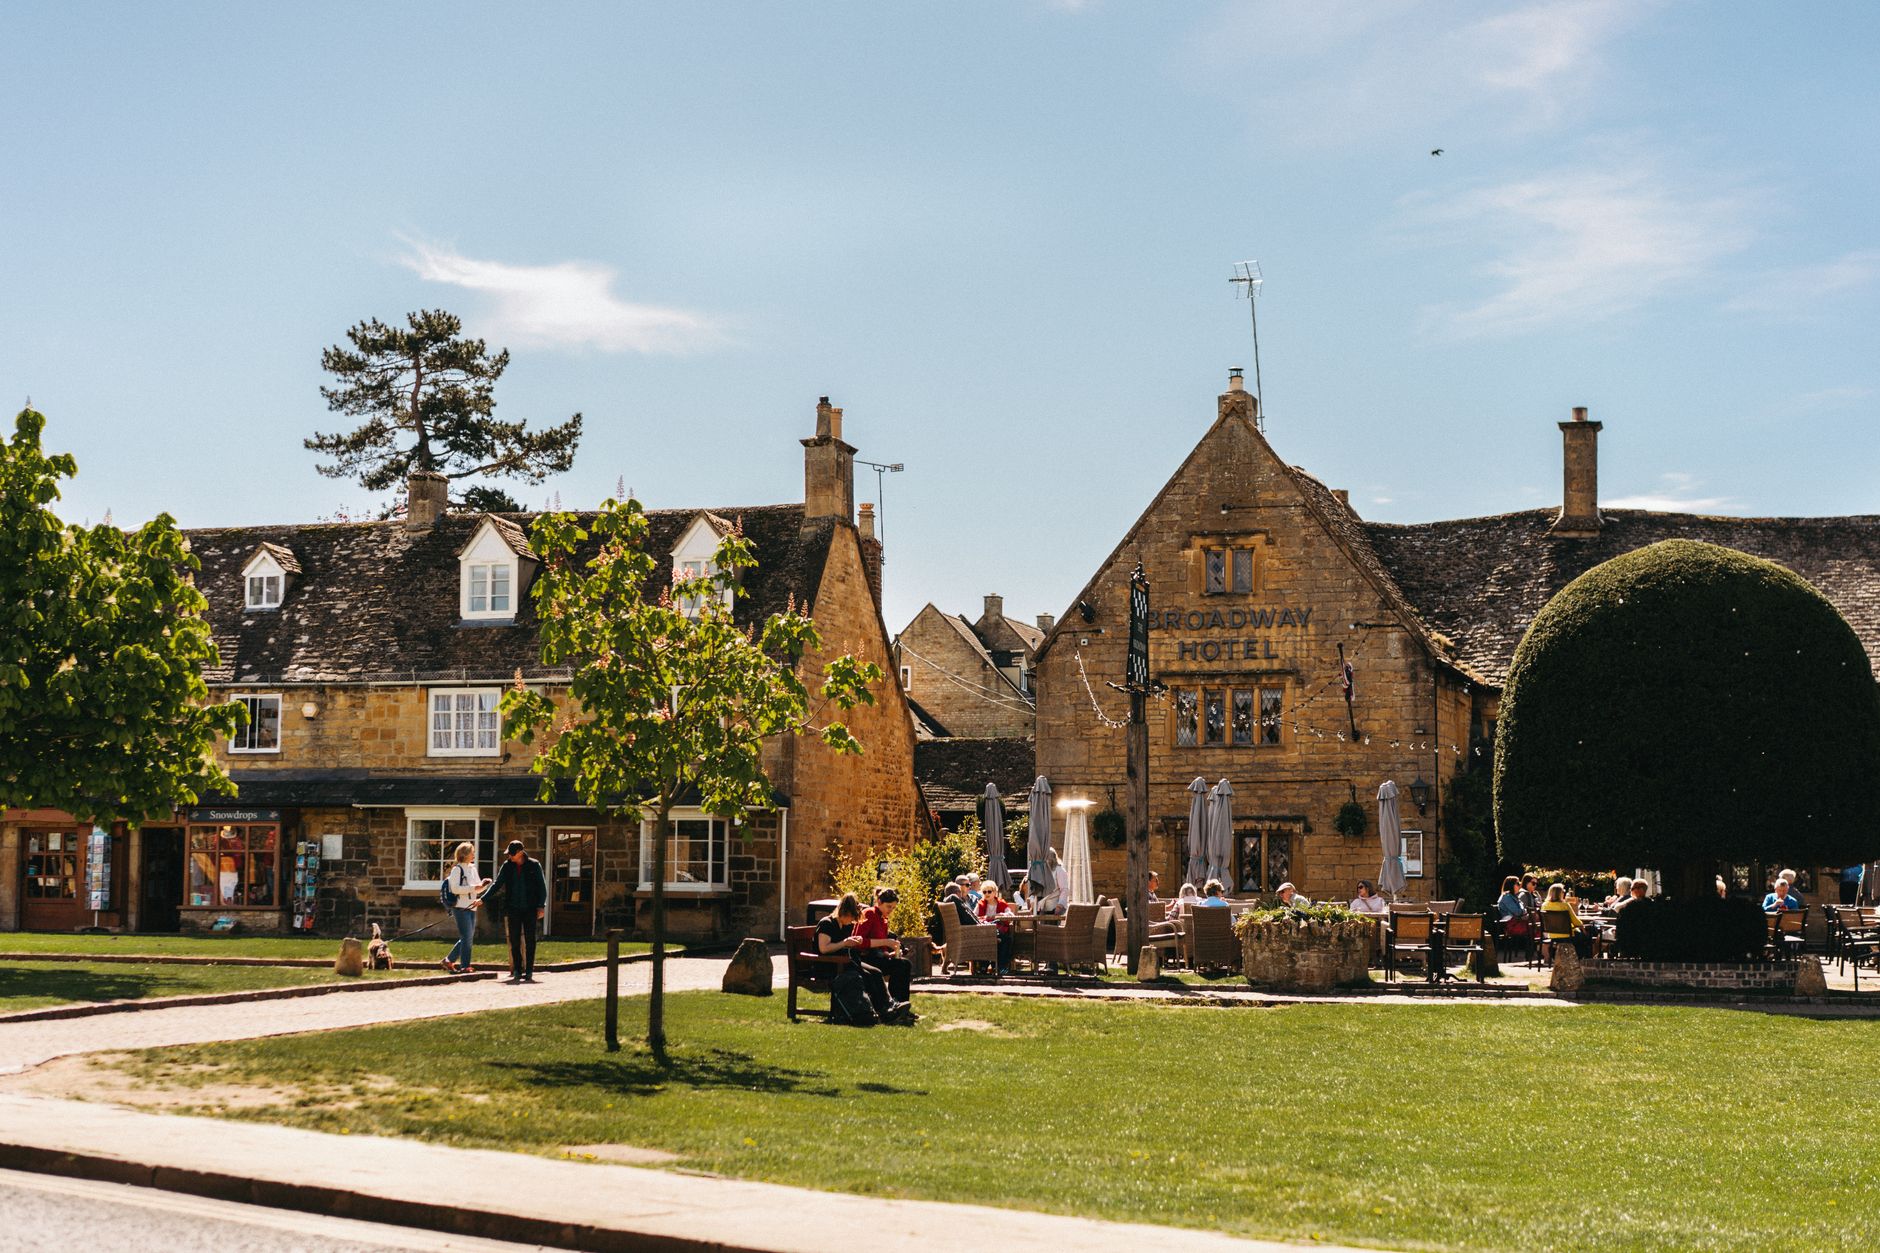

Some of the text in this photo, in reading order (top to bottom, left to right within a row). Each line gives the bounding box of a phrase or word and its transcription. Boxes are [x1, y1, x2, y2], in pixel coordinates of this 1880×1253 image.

[1147, 608, 1312, 630] BROADWAY
[1179, 639, 1279, 661] HOTEL
[209, 810, 258, 821] Snowdrops
